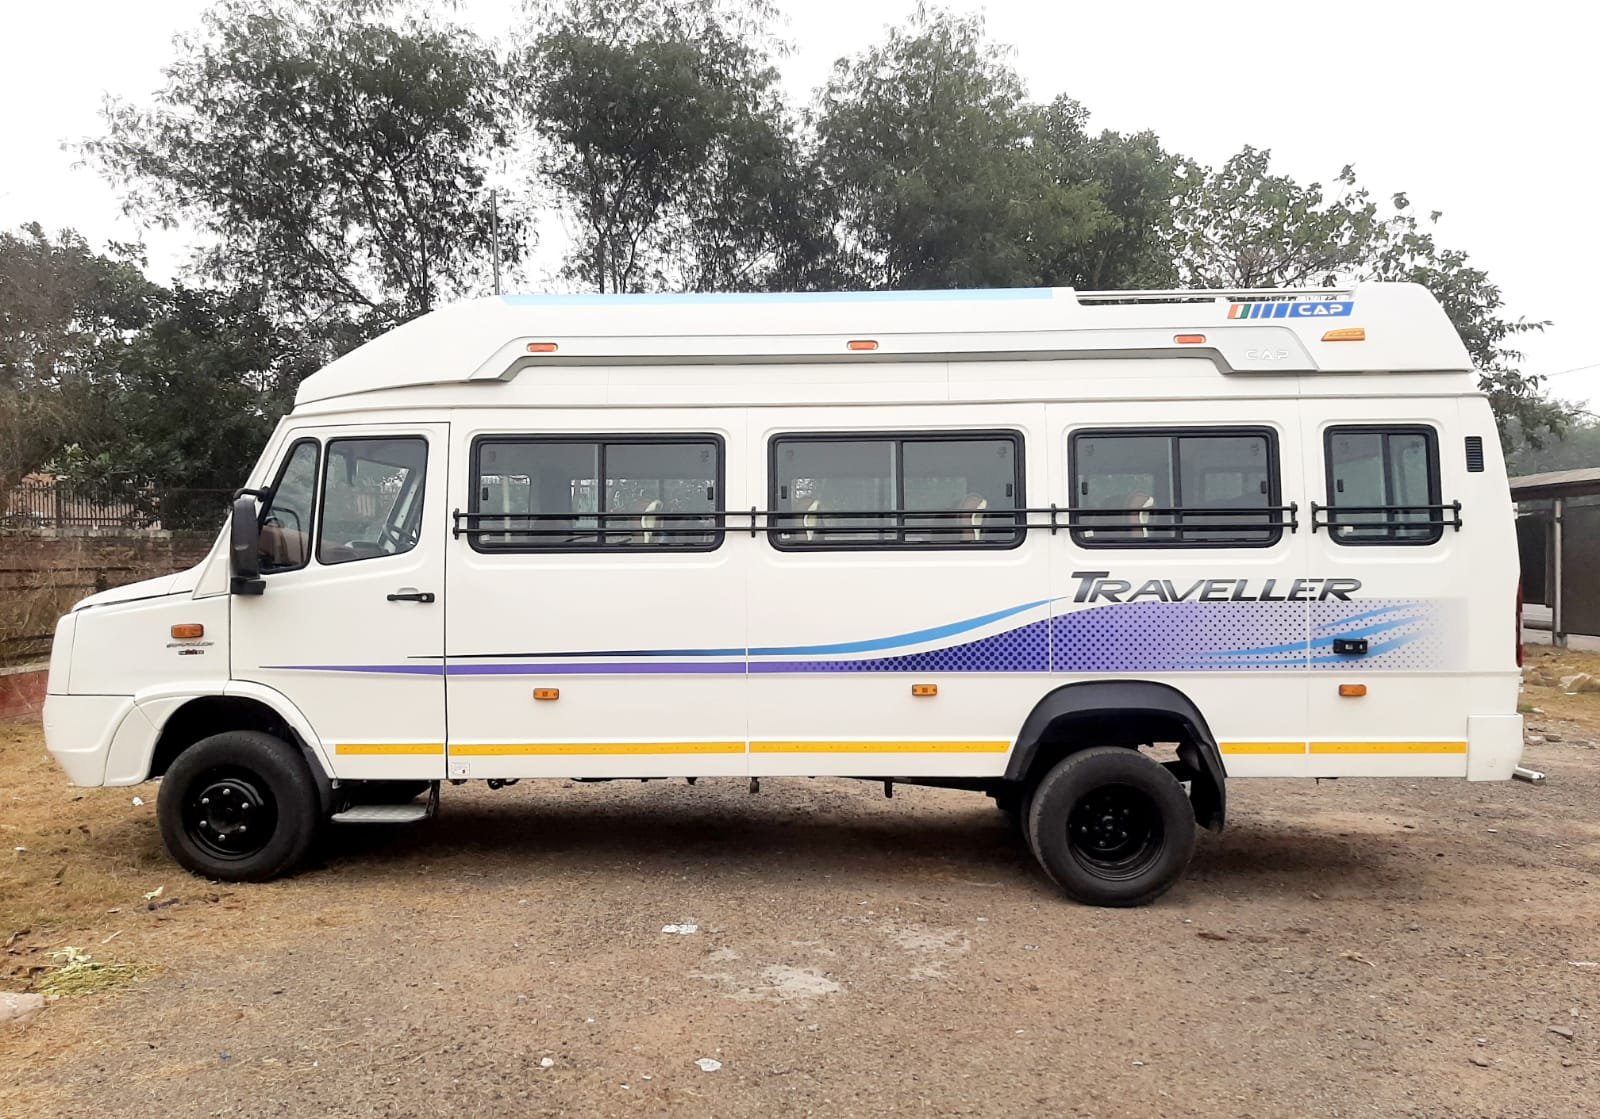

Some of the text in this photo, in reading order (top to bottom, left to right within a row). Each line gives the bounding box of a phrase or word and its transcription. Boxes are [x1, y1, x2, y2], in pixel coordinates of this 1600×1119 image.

[1298, 304, 1343, 315] CAP
[1246, 350, 1289, 361] CAP
[1071, 571, 1362, 603] TRAVELLER
